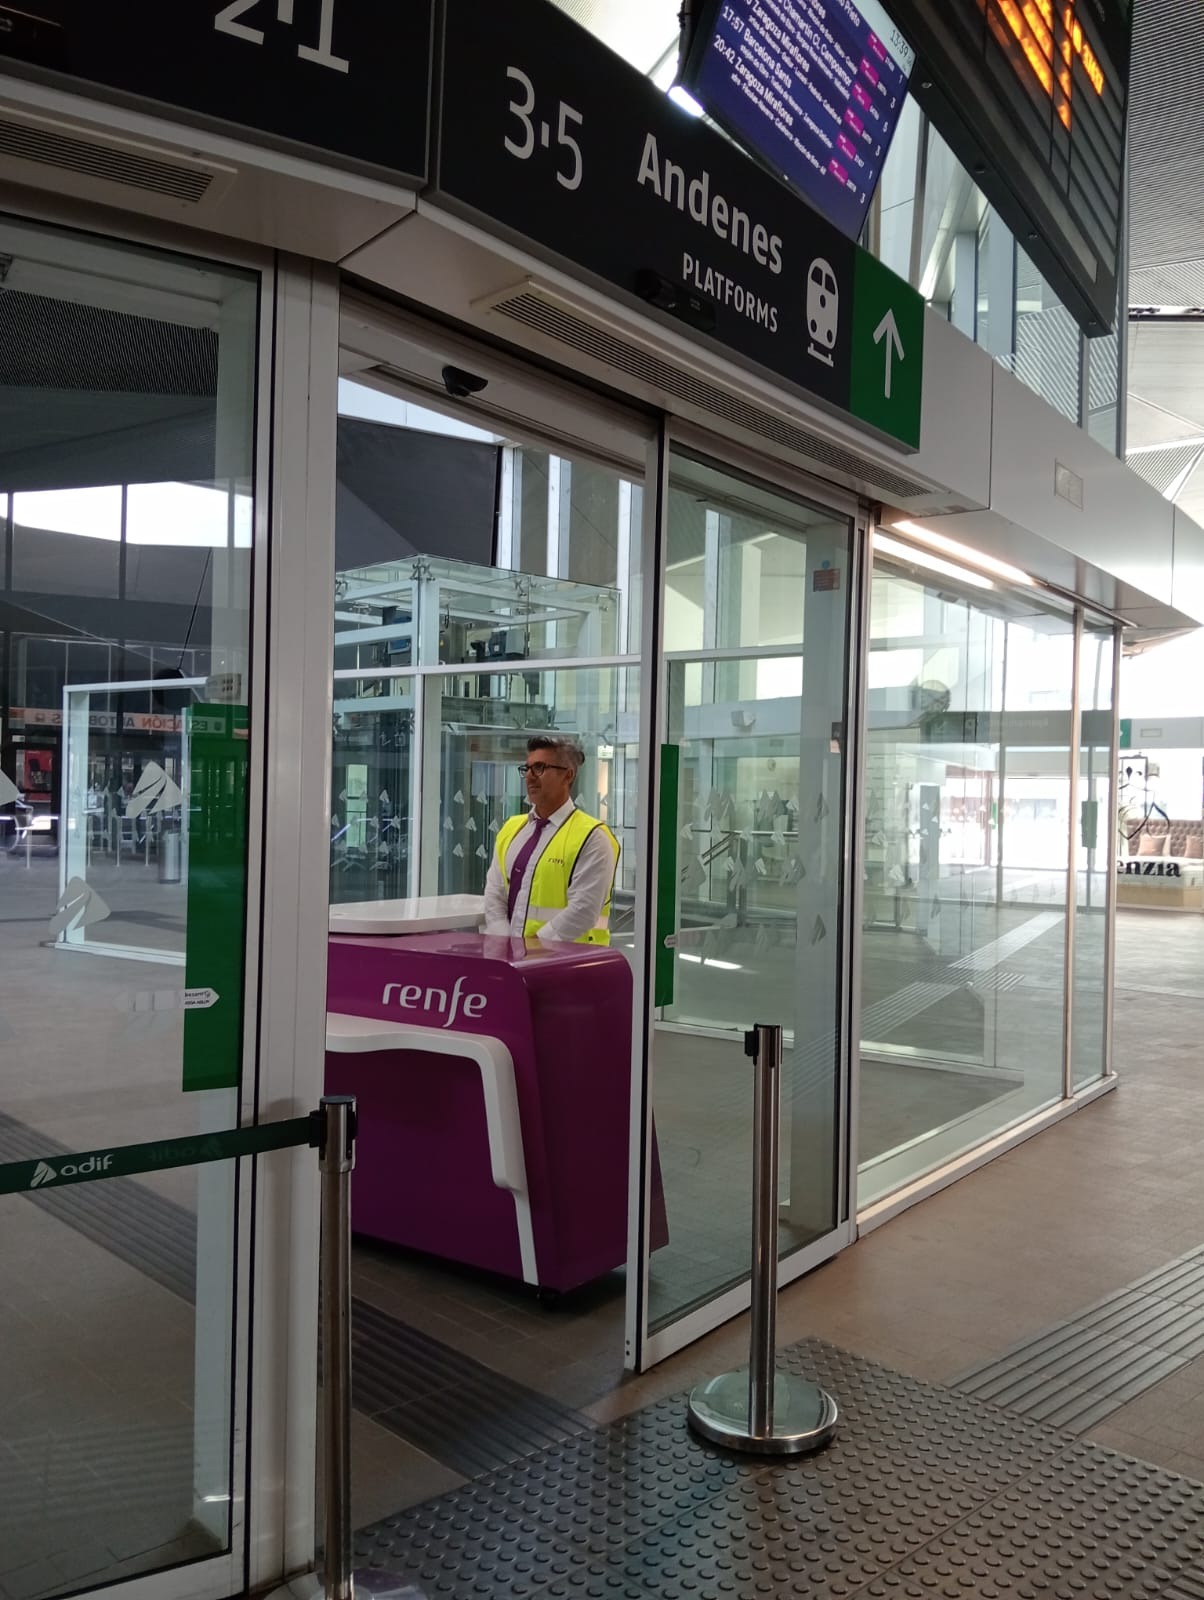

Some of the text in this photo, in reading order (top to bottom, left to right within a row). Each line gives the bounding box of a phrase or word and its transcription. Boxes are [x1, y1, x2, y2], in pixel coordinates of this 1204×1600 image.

[712, 33, 736, 65] 20:42
[734, 55, 765, 98] Zaragoza
[762, 87, 794, 127] Miraflores
[721, 4, 744, 35] 17:57
[742, 26, 776, 70] Barcelona
[774, 61, 793, 89] Sants
[889, 28, 909, 59] 13:39
[637, 133, 782, 274] Andenes
[683, 252, 778, 333] PLATFORMS
[382, 976, 487, 1027] renfe
[60, 1154, 113, 1176] adif
